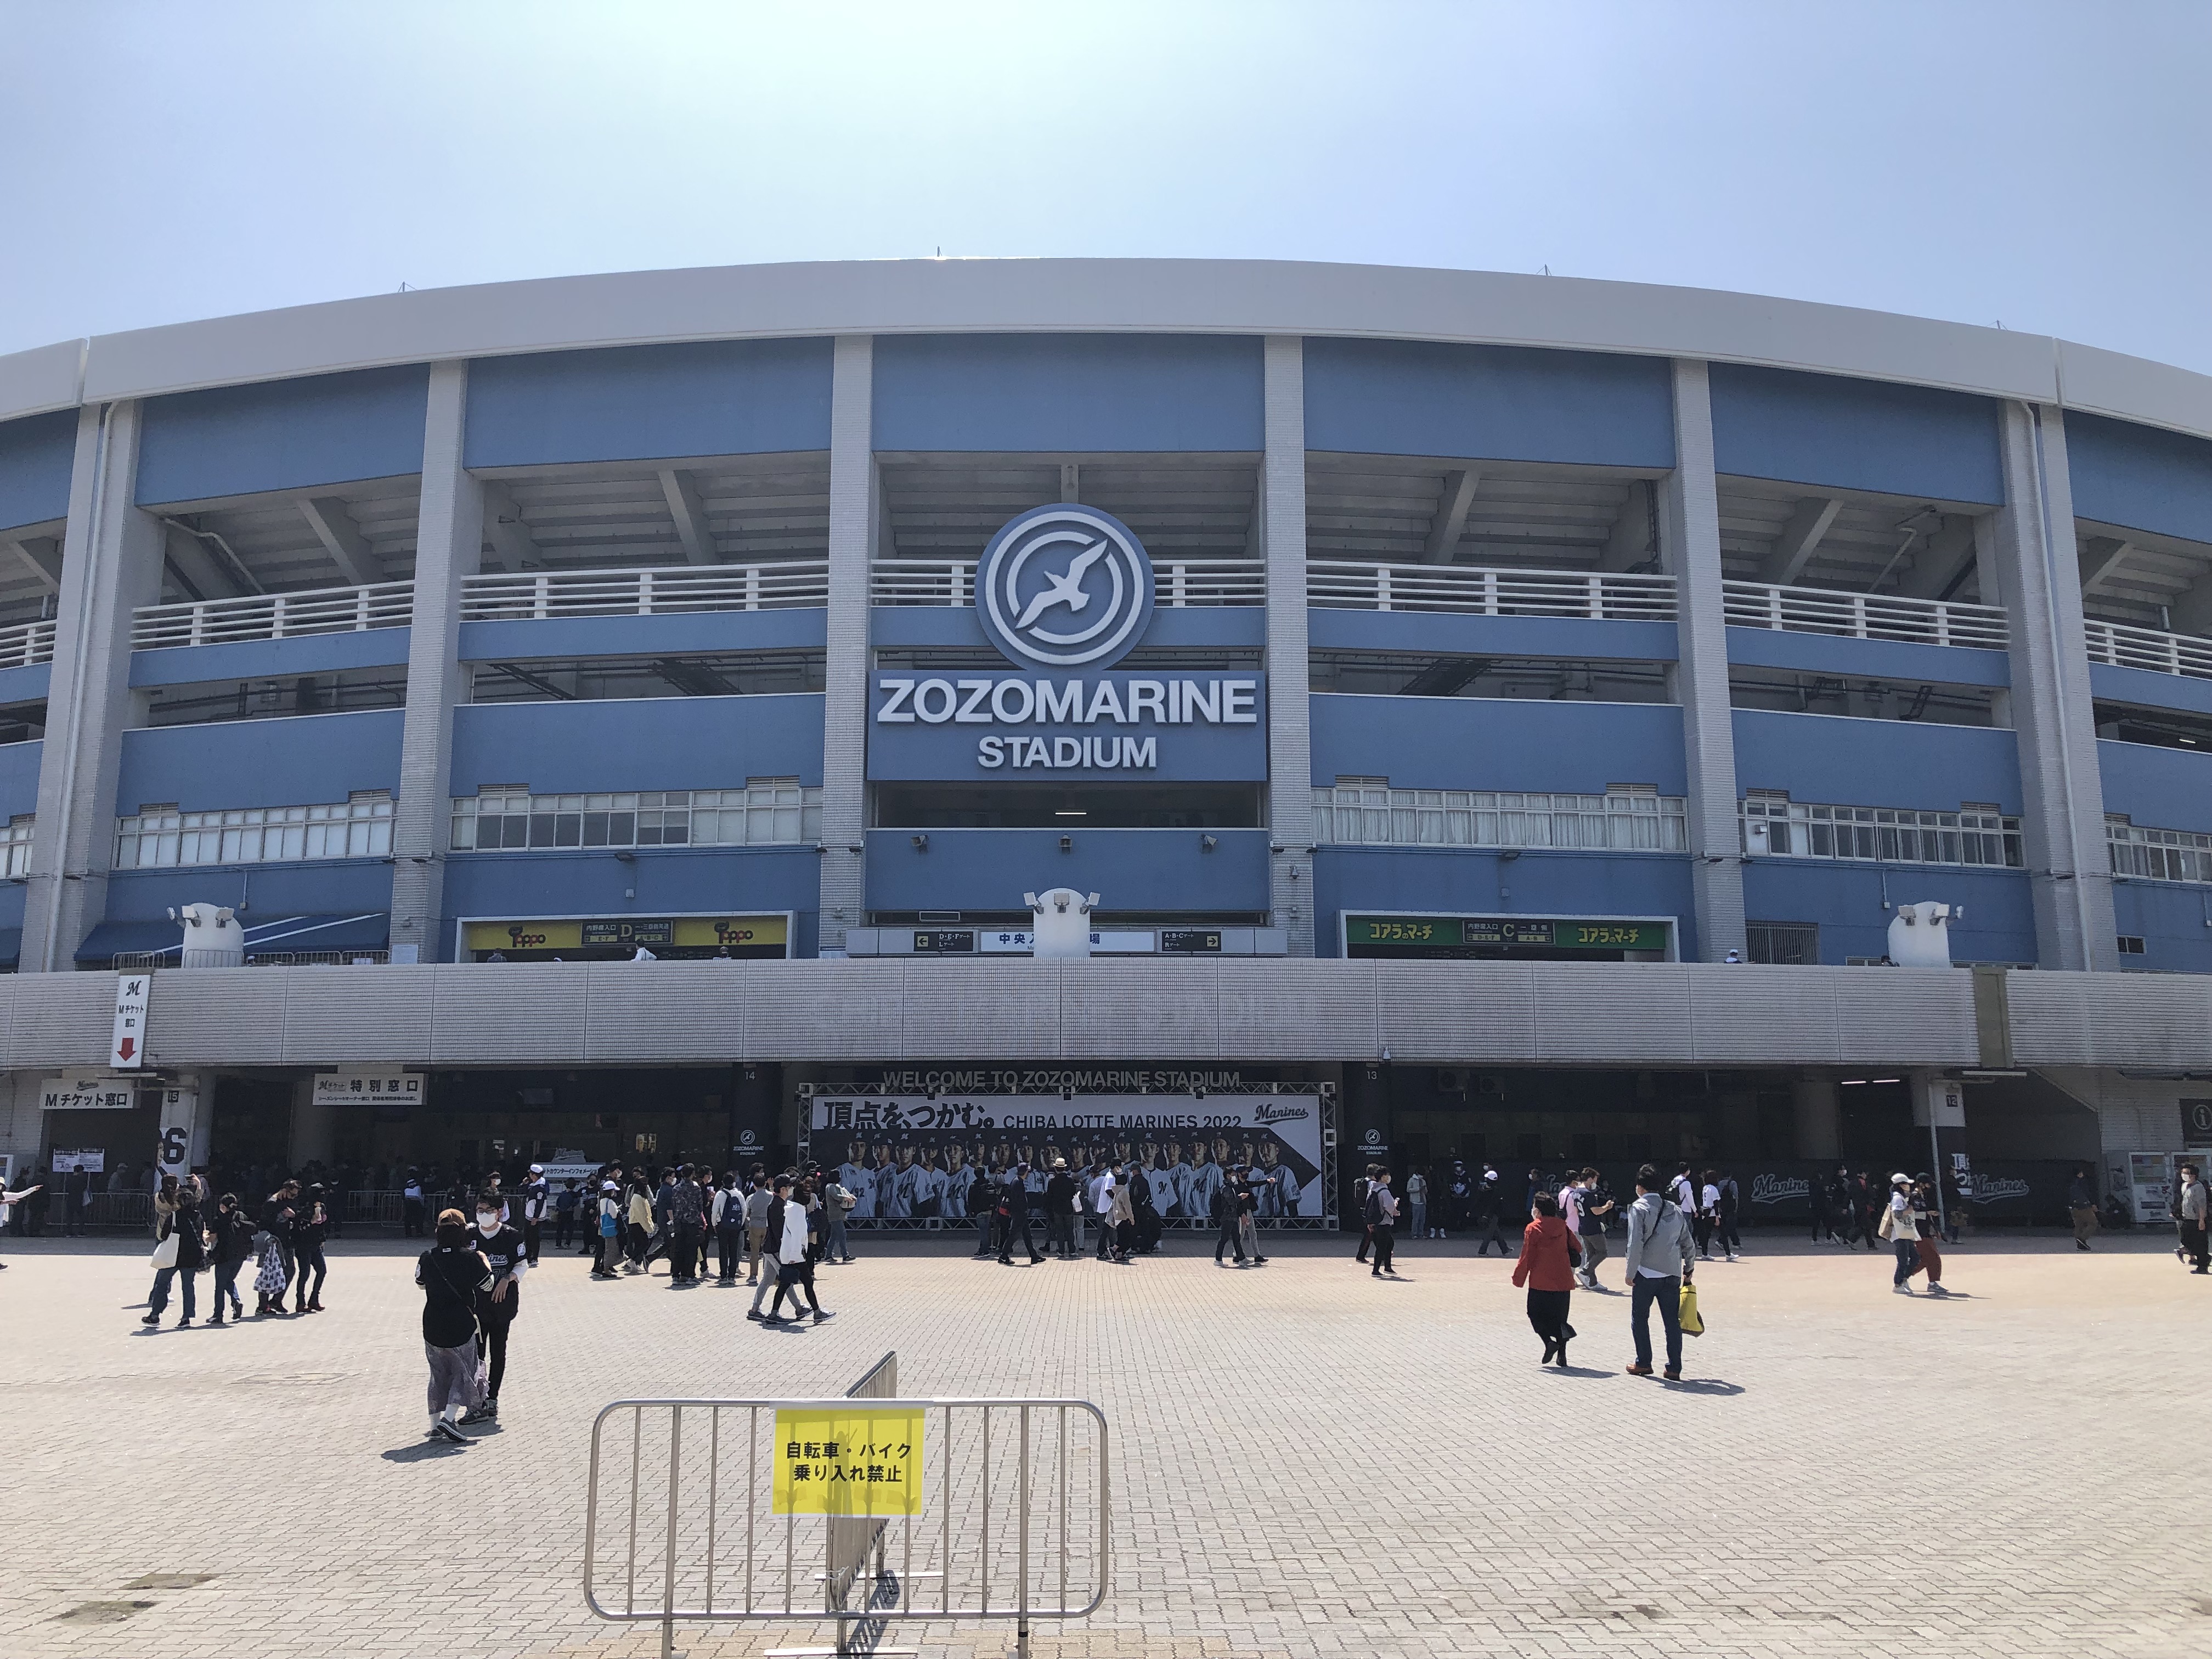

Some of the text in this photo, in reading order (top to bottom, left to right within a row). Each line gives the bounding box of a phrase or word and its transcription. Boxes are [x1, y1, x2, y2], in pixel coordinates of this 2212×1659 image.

[877, 678, 1257, 724] ZOZOMARINE
[978, 736, 1158, 769] STADIUM
[620, 924, 633, 938] D
[1369, 923, 1433, 940] コアラのマーチ
[1503, 923, 1515, 937] C
[1578, 927, 1639, 944] コアラのマーチ
[745, 1071, 755, 1080] 14
[883, 1070, 1241, 1087] WELCOME TO ZOZOMARINE STADIUM
[1367, 1071, 1377, 1080] 13
[350, 1079, 418, 1092] 特別窓口
[45, 1092, 128, 1107] Mチケット窓口
[823, 1101, 995, 1129] 頂点を、つかむ。
[1003, 1115, 1242, 1128] CHIBA LOTTE MARINES 2022
[1253, 1103, 1310, 1126] Marines
[1751, 1174, 1810, 1204] Marine
[787, 1441, 912, 1459] 自転車・バイク
[793, 1464, 903, 1482] 乗り入れ禁止
